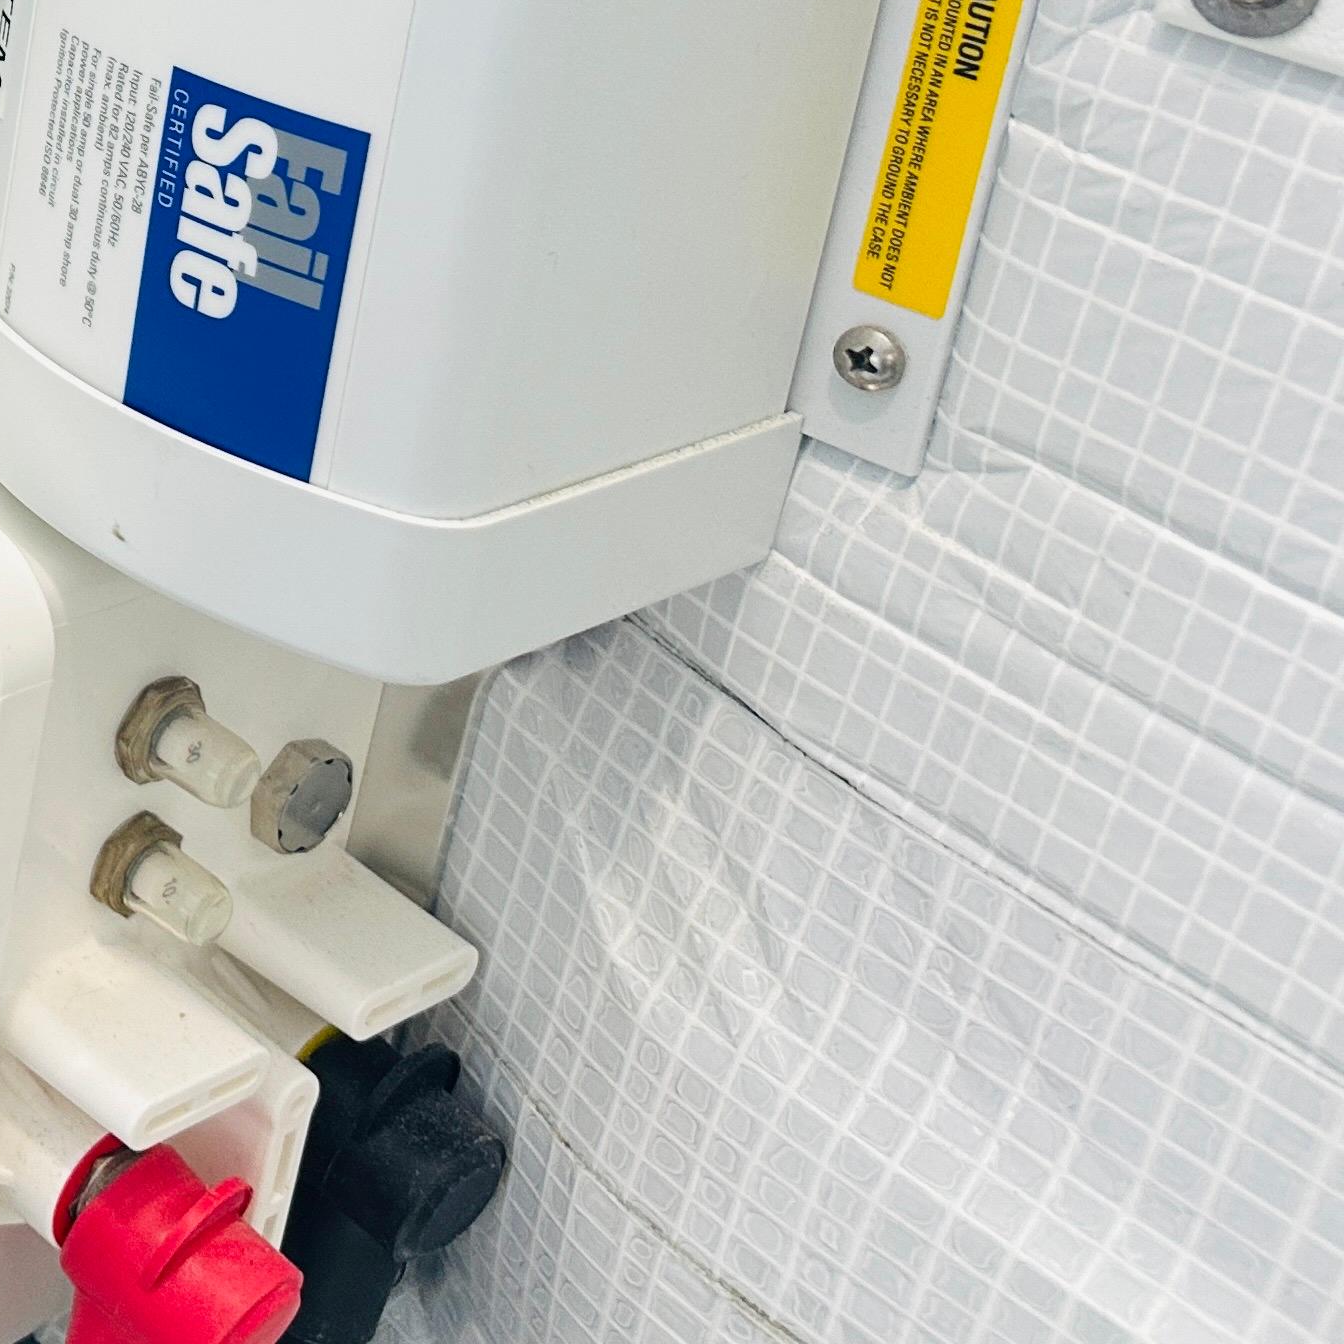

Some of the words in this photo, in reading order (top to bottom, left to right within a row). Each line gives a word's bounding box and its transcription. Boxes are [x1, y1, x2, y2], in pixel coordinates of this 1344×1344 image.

[918, 22, 935, 49] NOT
[63, 34, 79, 96] Capacitor
[77, 40, 89, 83] power
[90, 47, 101, 69] For
[83, 70, 96, 109] single
[113, 62, 129, 102] Rated
[900, 51, 928, 125] NECESSARY
[45, 77, 62, 140] Protected
[65, 85, 82, 162] applications
[110, 102, 122, 120] for
[142, 77, 161, 132] Fail-Safe
[920, 89, 938, 122] AREA
[55, 98, 69, 152] installed
[75, 128, 87, 157] amp
[102, 140, 114, 176] amps
[139, 133, 149, 157] per
[157, 88, 189, 207] CERTIFIED
[908, 125, 930, 170] WHERE
[70, 174, 82, 205] dual
[881, 145, 905, 199] GROUND
[91, 178, 108, 249] continuous
[170, 105, 279, 317] Safe
[230, 123, 347, 310] Fail
[874, 202, 892, 225] THE
[895, 172, 918, 227] AMBIENT
[62, 220, 74, 249] amp
[885, 228, 904, 261] DOES
[58, 250, 71, 287] shore
[86, 250, 100, 279] duty
[879, 263, 896, 289] NOT
